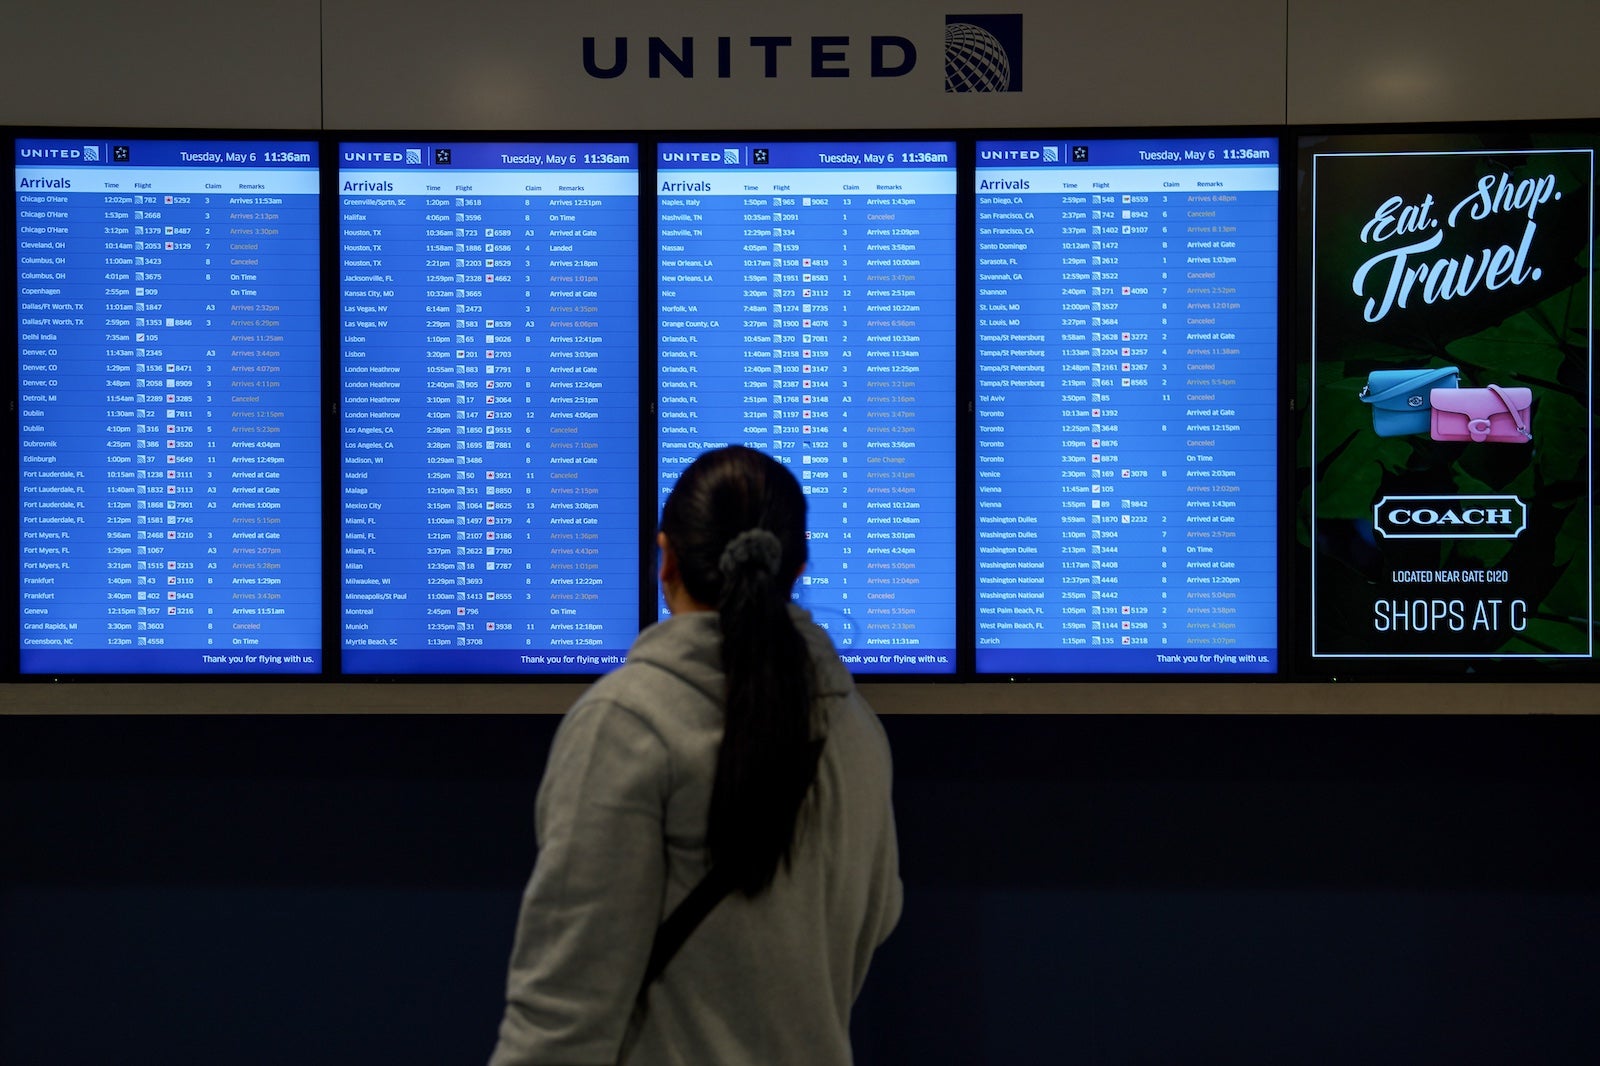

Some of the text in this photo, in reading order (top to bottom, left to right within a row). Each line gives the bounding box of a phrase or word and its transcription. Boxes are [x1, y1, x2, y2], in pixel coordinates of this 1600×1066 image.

[583, 36, 917, 79] UNITED
[21, 149, 80, 158] UNITED
[181, 152, 310, 162] Tuesday, May 6 11:36am
[345, 153, 402, 161] UNITED
[663, 153, 720, 162] UNITED
[819, 153, 947, 164] Tuesday, May 6 11:36am
[982, 151, 1039, 159] UNITED
[1139, 149, 1269, 161] Tuesday, May 6 11:36am
[502, 154, 630, 165] Tuesday, May 6 11:36am
[20, 177, 71, 188] Arrivals
[344, 181, 393, 192] Arrivals
[662, 181, 711, 192] Arrivals
[980, 179, 1030, 190] Arrivals
[1360, 172, 1562, 244] Eat. Shop.
[344, 229, 370, 237] Houston,
[426, 229, 453, 237] 10:36am
[980, 258, 1008, 266] Sarasota,
[1352, 220, 1542, 322] Travel.
[662, 350, 688, 358] Orlando,
[24, 455, 56, 464] Edinburgh
[107, 456, 131, 464] 1:00pm
[368, 502, 381, 510] City
[427, 502, 451, 510] 3:15pm
[575, 502, 598, 510] 3:08pm
[1062, 501, 1086, 509] 1:55pm
[980, 516, 1015, 524] Washington
[1388, 509, 1512, 525] COACH
[892, 532, 915, 540] 3:01pm
[1393, 571, 1508, 583] LOCATED NEAR GATE C120
[1374, 600, 1526, 631] SHOPS AT C
[203, 655, 227, 663] Thank
[229, 657, 243, 665] you
[245, 655, 256, 663] for
[259, 655, 281, 665] flying
[284, 655, 300, 663] with
[521, 655, 545, 664] Thank
[547, 657, 561, 665] you
[563, 655, 574, 664] for
[577, 655, 599, 665] flying
[601, 655, 618, 664] with
[864, 657, 878, 665] you
[880, 655, 891, 663] for
[893, 655, 915, 664] flying
[918, 655, 935, 663] with
[1157, 655, 1181, 663] Thank
[1200, 655, 1211, 663] for
[1213, 655, 1236, 664] flying
[1239, 655, 1255, 663] with
